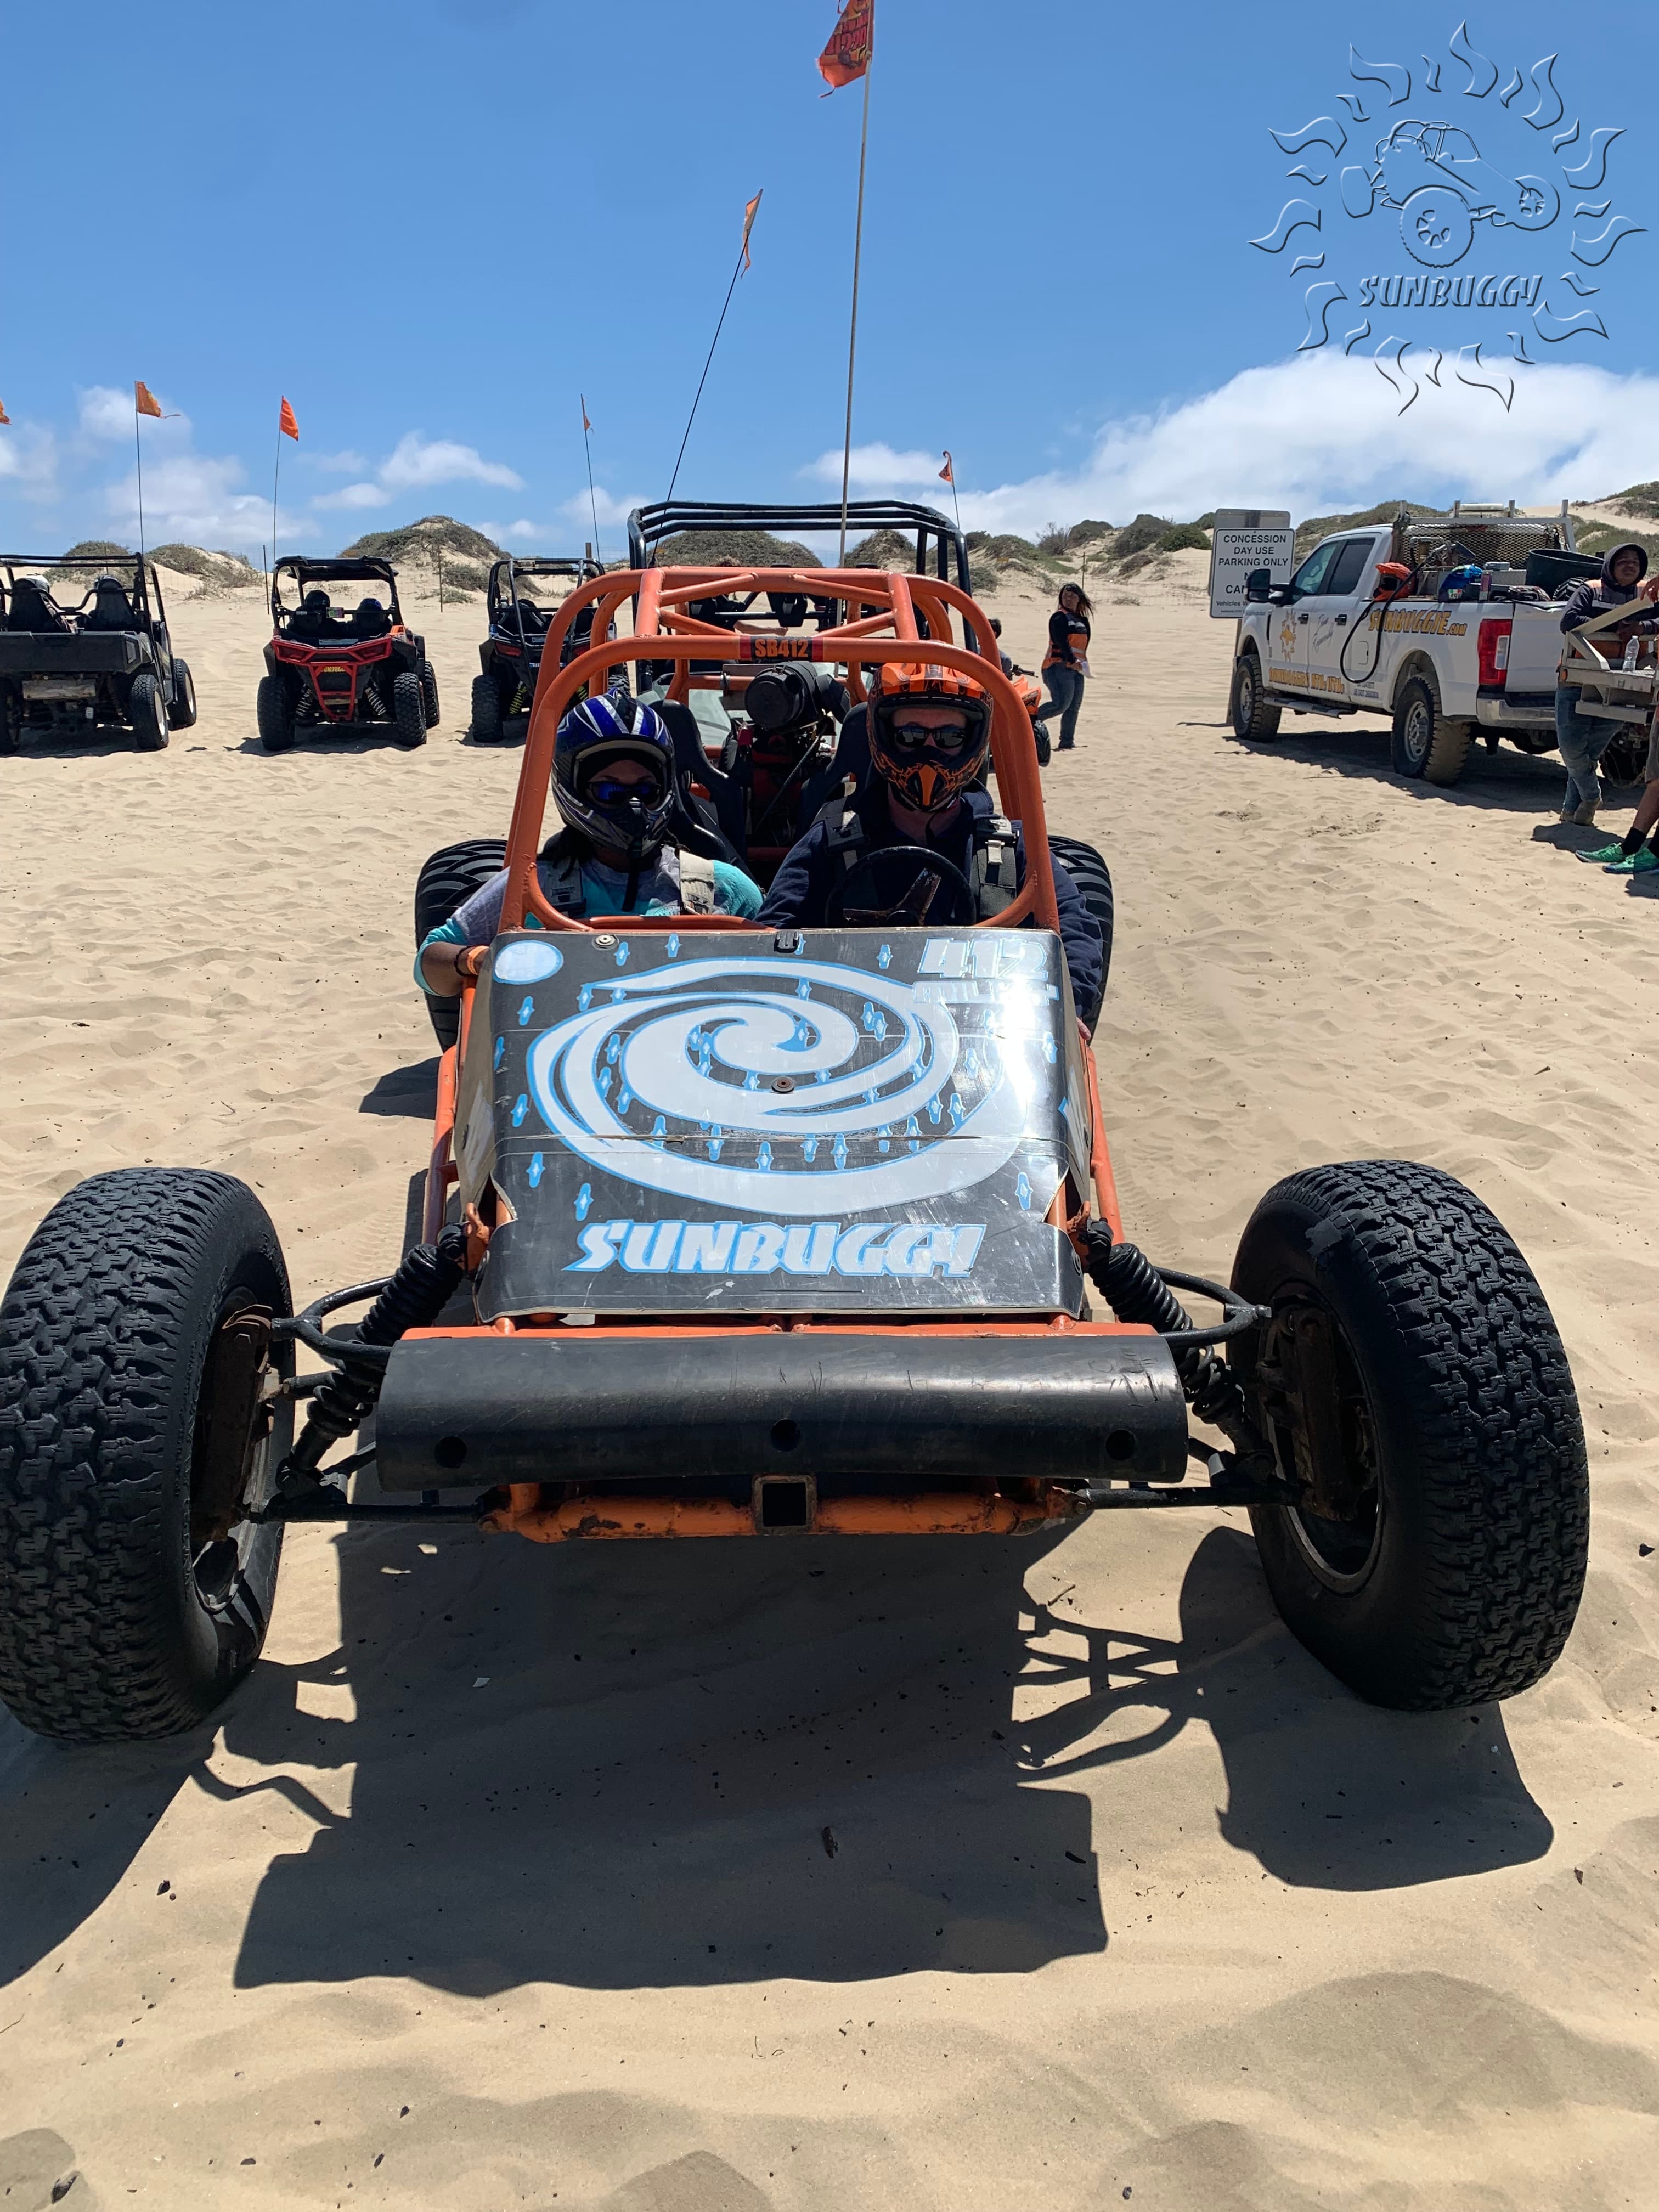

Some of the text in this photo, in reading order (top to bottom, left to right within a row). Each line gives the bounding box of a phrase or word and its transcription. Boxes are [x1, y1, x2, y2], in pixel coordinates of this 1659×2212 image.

[1223, 535, 1286, 543] CONCESSION
[754, 638, 808, 658] SB412
[917, 937, 1049, 981] 412
[561, 1220, 988, 1278] SUNBUGGY
